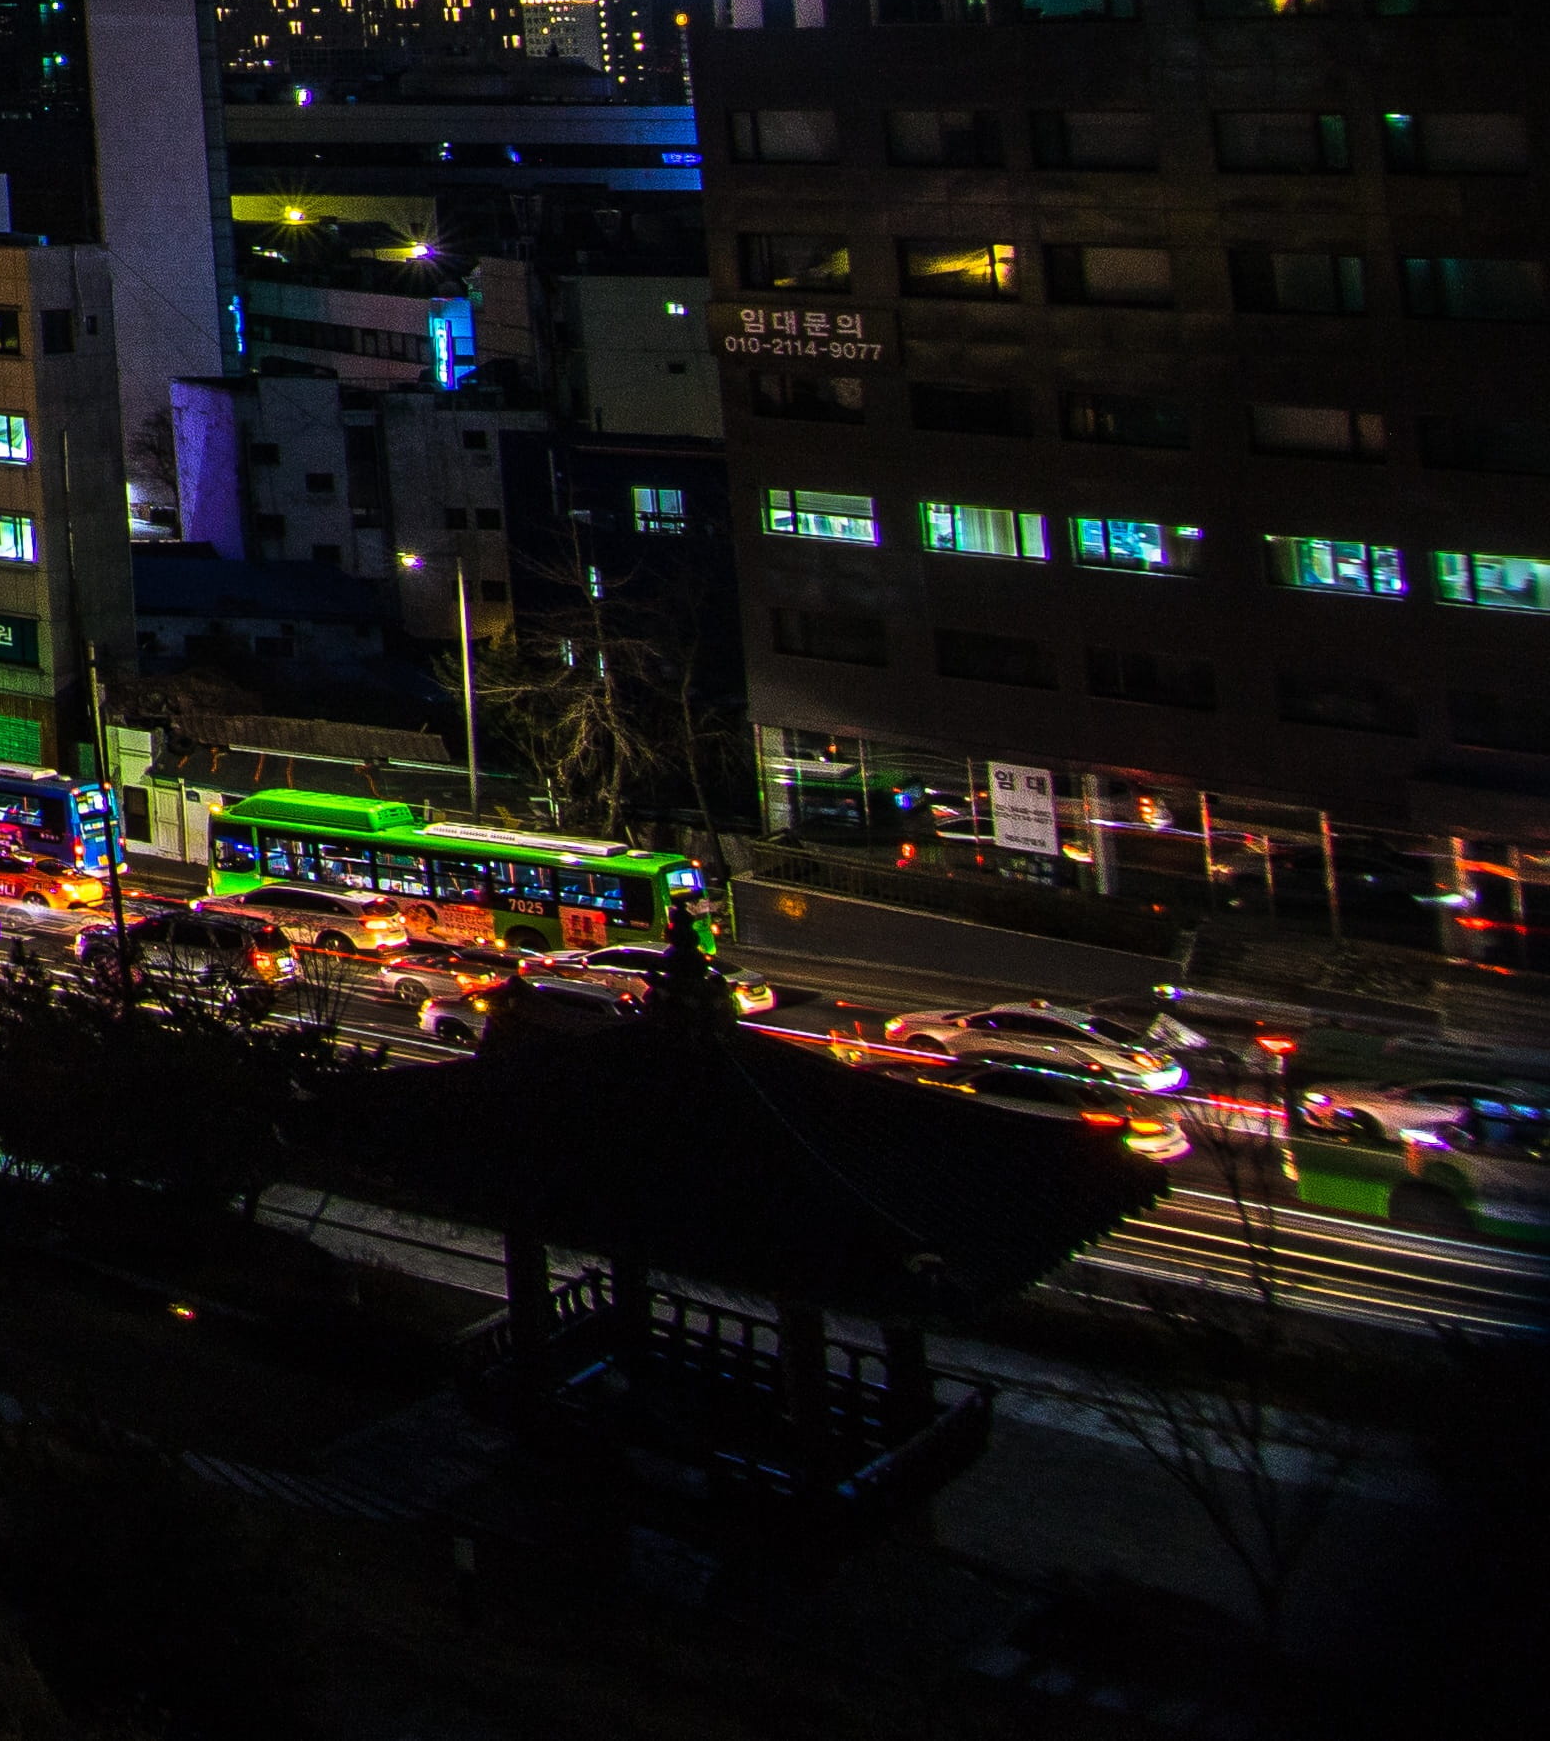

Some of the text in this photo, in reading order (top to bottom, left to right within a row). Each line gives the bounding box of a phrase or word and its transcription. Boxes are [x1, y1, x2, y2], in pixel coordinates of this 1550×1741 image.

[740, 309, 863, 339] 임대문의
[724, 335, 882, 361] 010-2114-9077
[994, 770, 1048, 796] 임대
[507, 897, 544, 916] 7025
